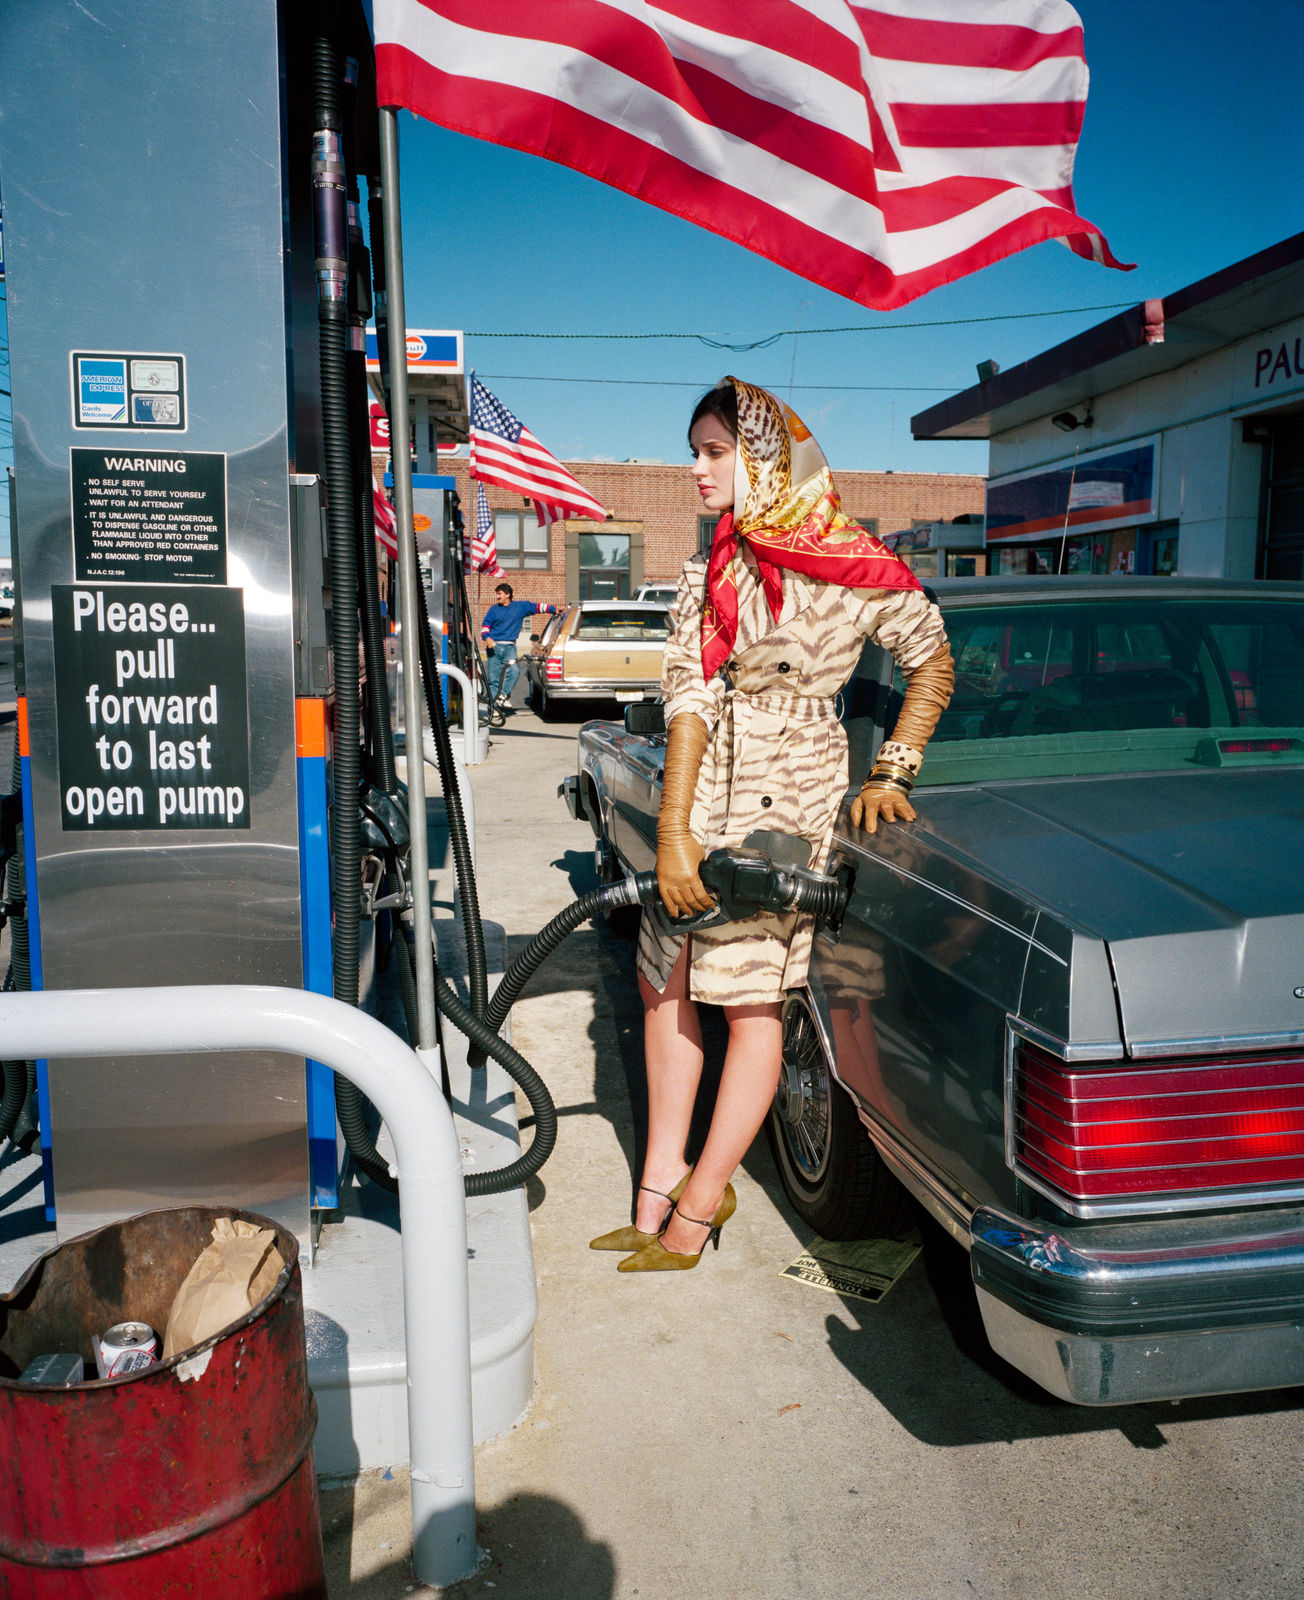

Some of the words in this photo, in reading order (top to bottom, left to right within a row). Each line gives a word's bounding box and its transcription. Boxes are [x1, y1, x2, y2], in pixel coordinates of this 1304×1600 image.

[81, 375, 123, 384] AMERICAN
[90, 384, 125, 392] EXPRESS
[104, 457, 187, 473] WARNING
[89, 488, 128, 496] UNLAWFUL
[168, 514, 213, 522] DANGEROUS
[116, 540, 154, 548] APPROVED
[174, 542, 218, 550] CONTAINERS
[72, 591, 216, 633] Please...
[115, 638, 175, 687] pull
[86, 684, 218, 724] forward
[95, 734, 133, 770] to
[148, 730, 212, 770] last
[66, 786, 144, 824] open
[158, 786, 244, 824] pump
